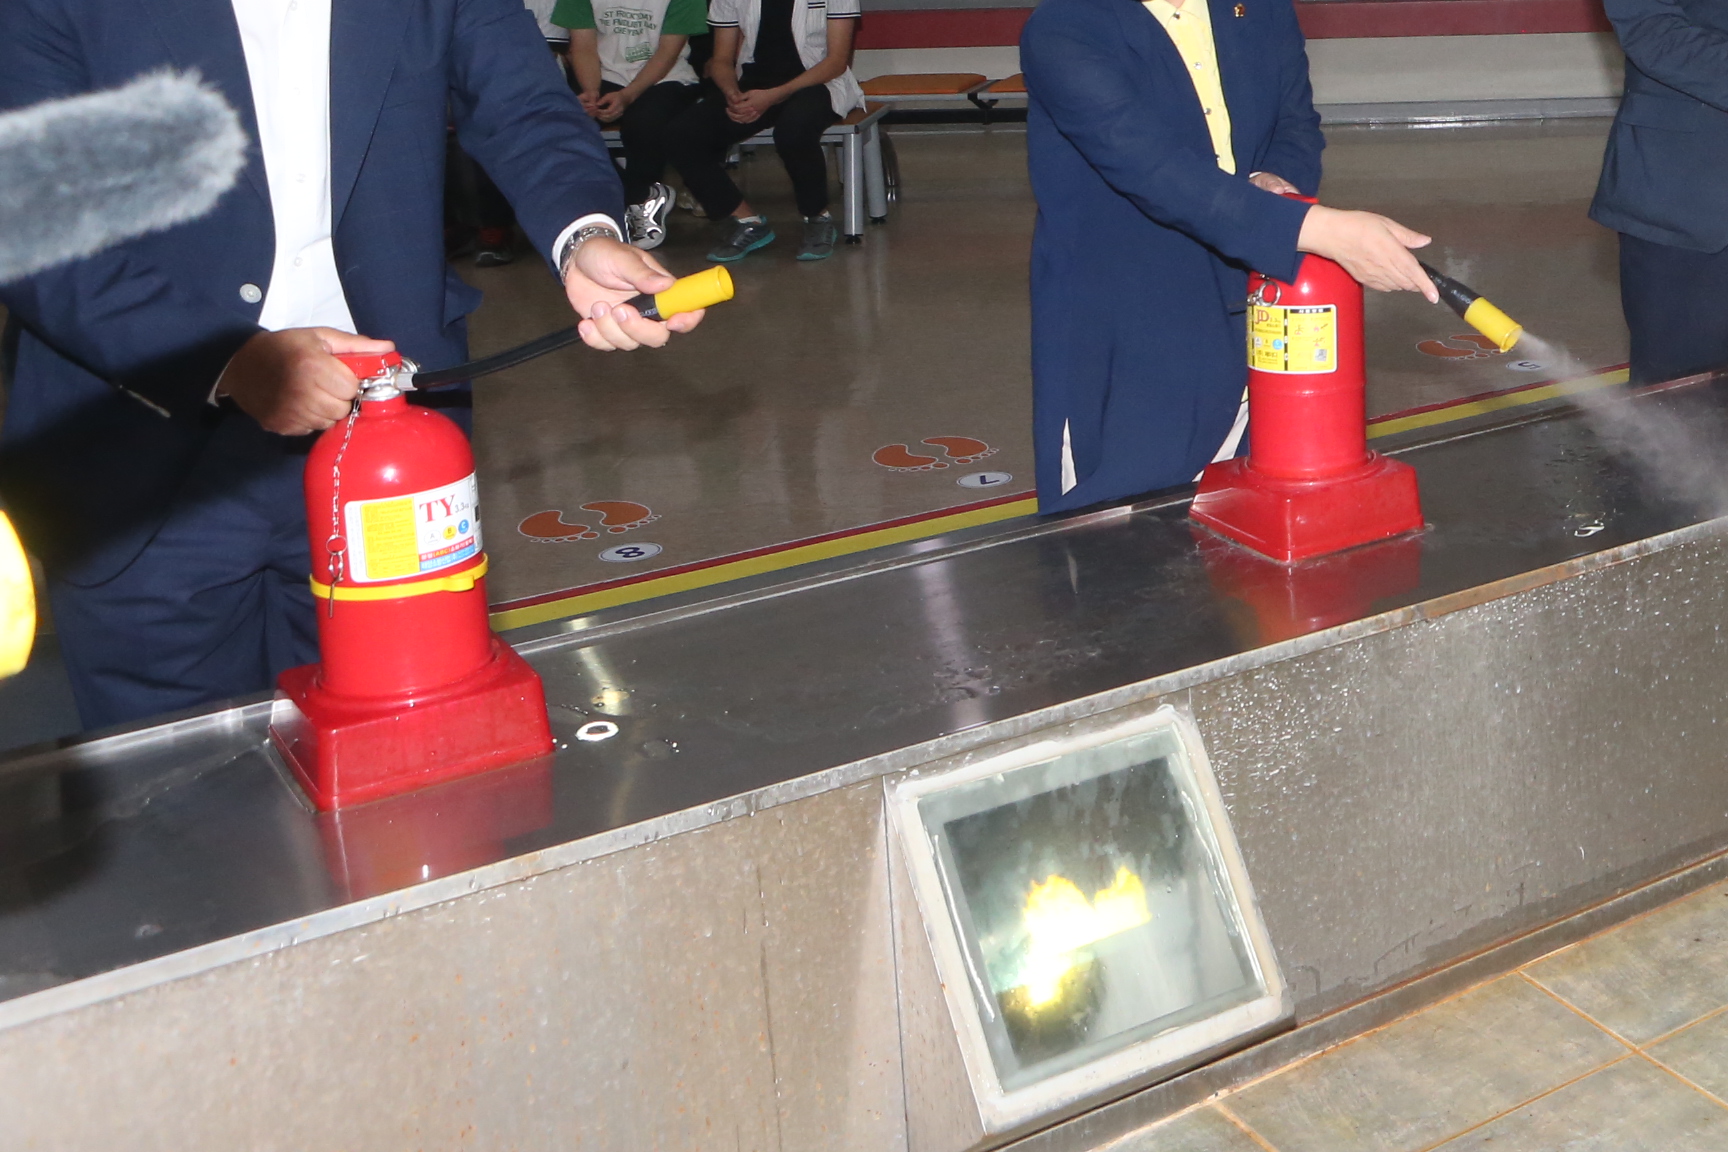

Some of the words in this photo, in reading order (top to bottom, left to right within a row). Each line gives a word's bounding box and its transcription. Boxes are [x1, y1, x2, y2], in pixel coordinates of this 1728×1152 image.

[1255, 309, 1270, 324] JD
[419, 494, 455, 523] TY
[615, 547, 645, 558] 8
